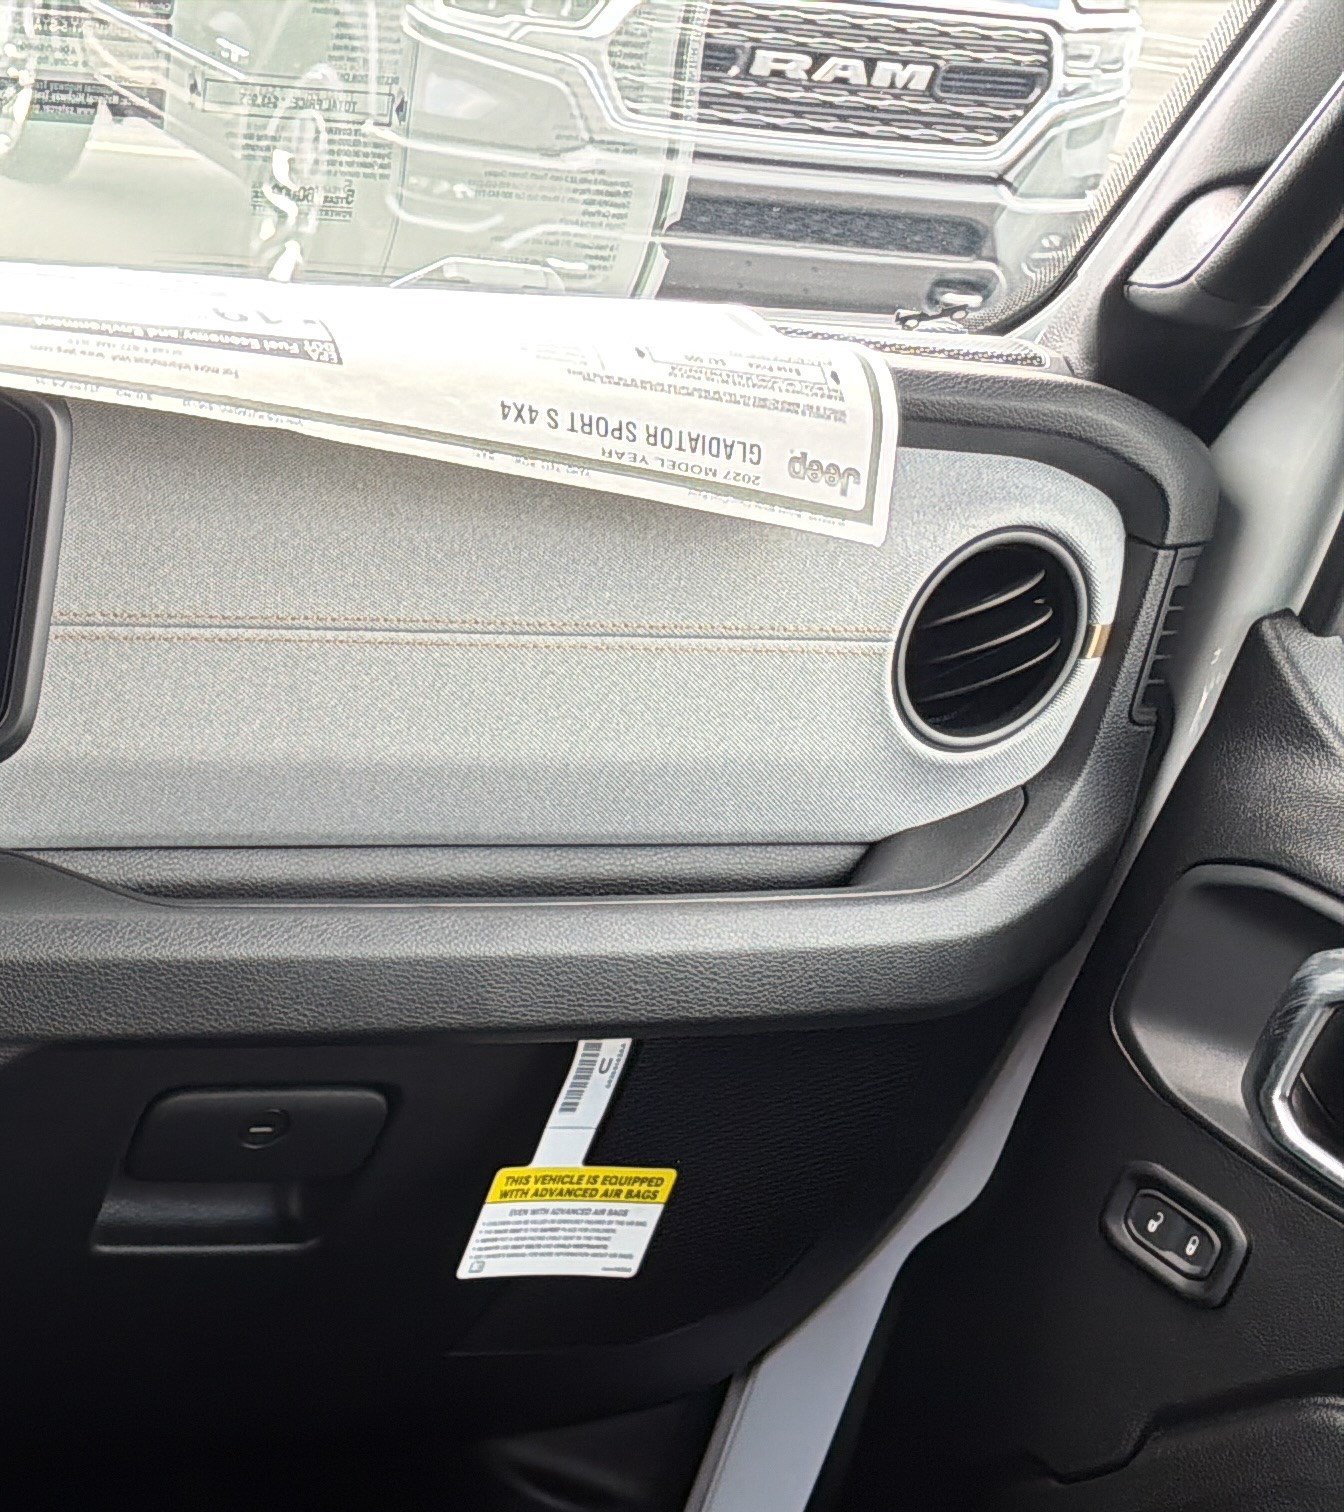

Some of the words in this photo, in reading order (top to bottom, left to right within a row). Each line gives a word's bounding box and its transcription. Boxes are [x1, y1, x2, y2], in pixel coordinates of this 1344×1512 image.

[749, 49, 936, 91] RAM
[499, 400, 539, 426] 4X4
[546, 409, 560, 430] S
[565, 412, 637, 443] SPORT
[645, 424, 762, 466] GLADIATOR
[600, 447, 649, 467] YEAR
[656, 457, 718, 478] MODEL
[724, 470, 762, 487] 2027
[787, 451, 862, 498] Jeep
[504, 1174, 532, 1187] THIS
[533, 1174, 585, 1186] VEHICLE
[585, 1174, 600, 1186] IS
[600, 1175, 665, 1188] EQUIPPED
[499, 1188, 530, 1199] WITH
[530, 1187, 600, 1199] ADVANCED
[600, 1188, 624, 1199] AIR
[624, 1189, 660, 1201] BAGS
